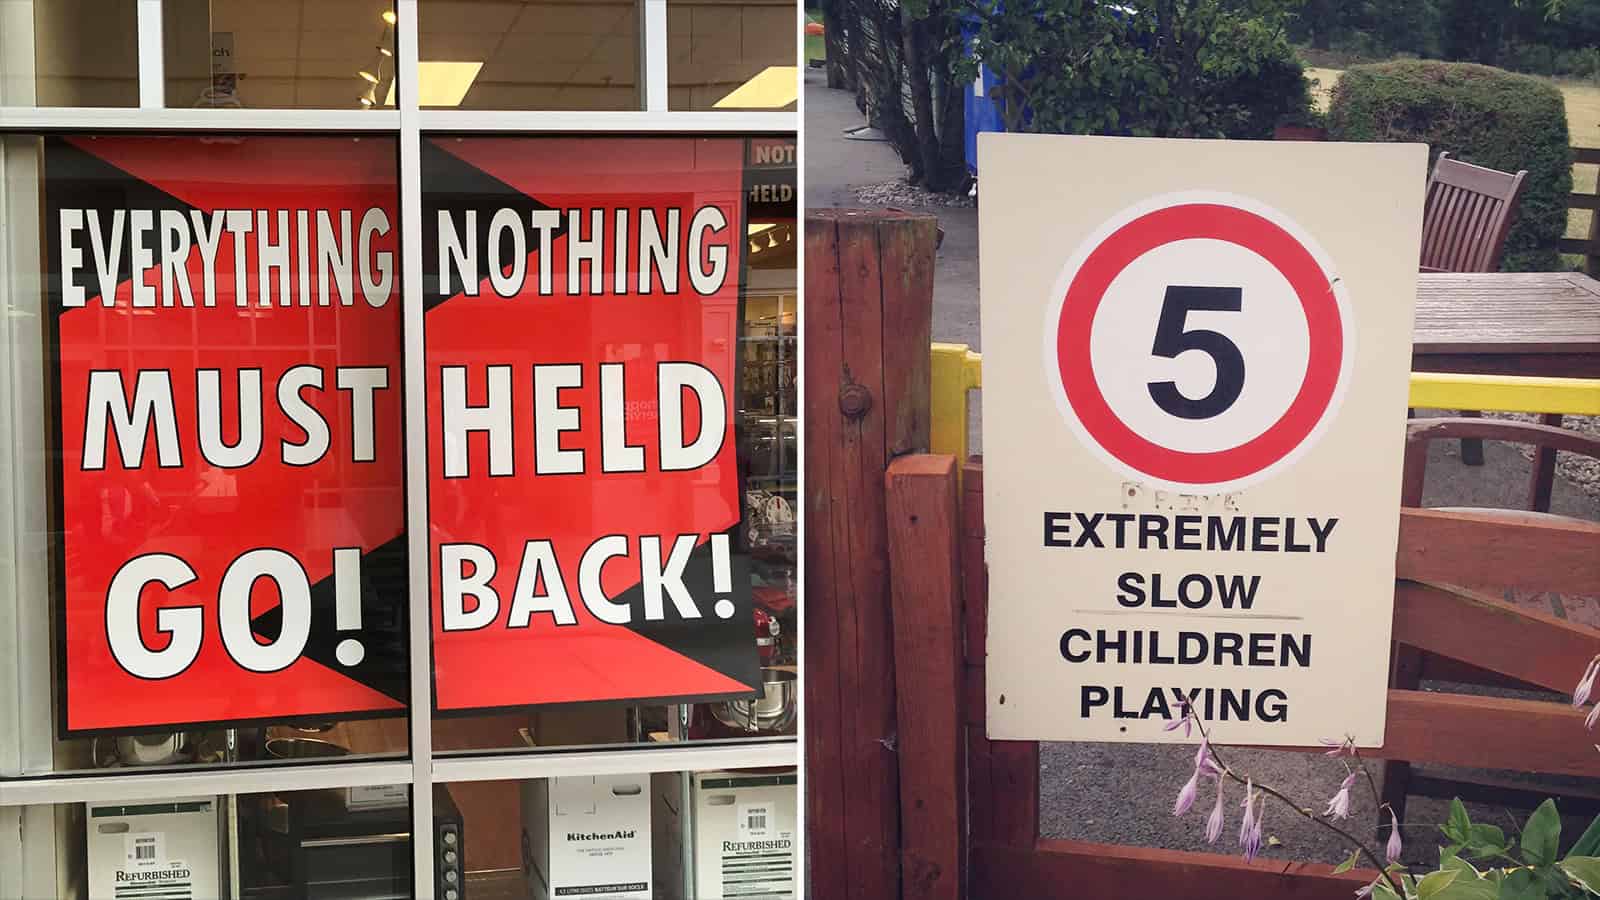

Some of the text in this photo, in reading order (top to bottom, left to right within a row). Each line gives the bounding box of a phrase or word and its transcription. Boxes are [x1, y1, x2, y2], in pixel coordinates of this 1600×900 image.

[59, 207, 393, 308] EVERYTHING
[438, 207, 727, 297] NOTHING
[1147, 285, 1245, 420] 5
[83, 366, 387, 469] MUST
[442, 363, 726, 477] HELD
[1044, 511, 1339, 553] EXTREMELY
[106, 548, 365, 679] GO!
[441, 534, 735, 631] BACK!
[1116, 572, 1262, 610] SLOW
[1059, 628, 1312, 668] CHILDREN
[1080, 685, 1288, 723] PLAYING
[567, 831, 637, 841] KitchenAid
